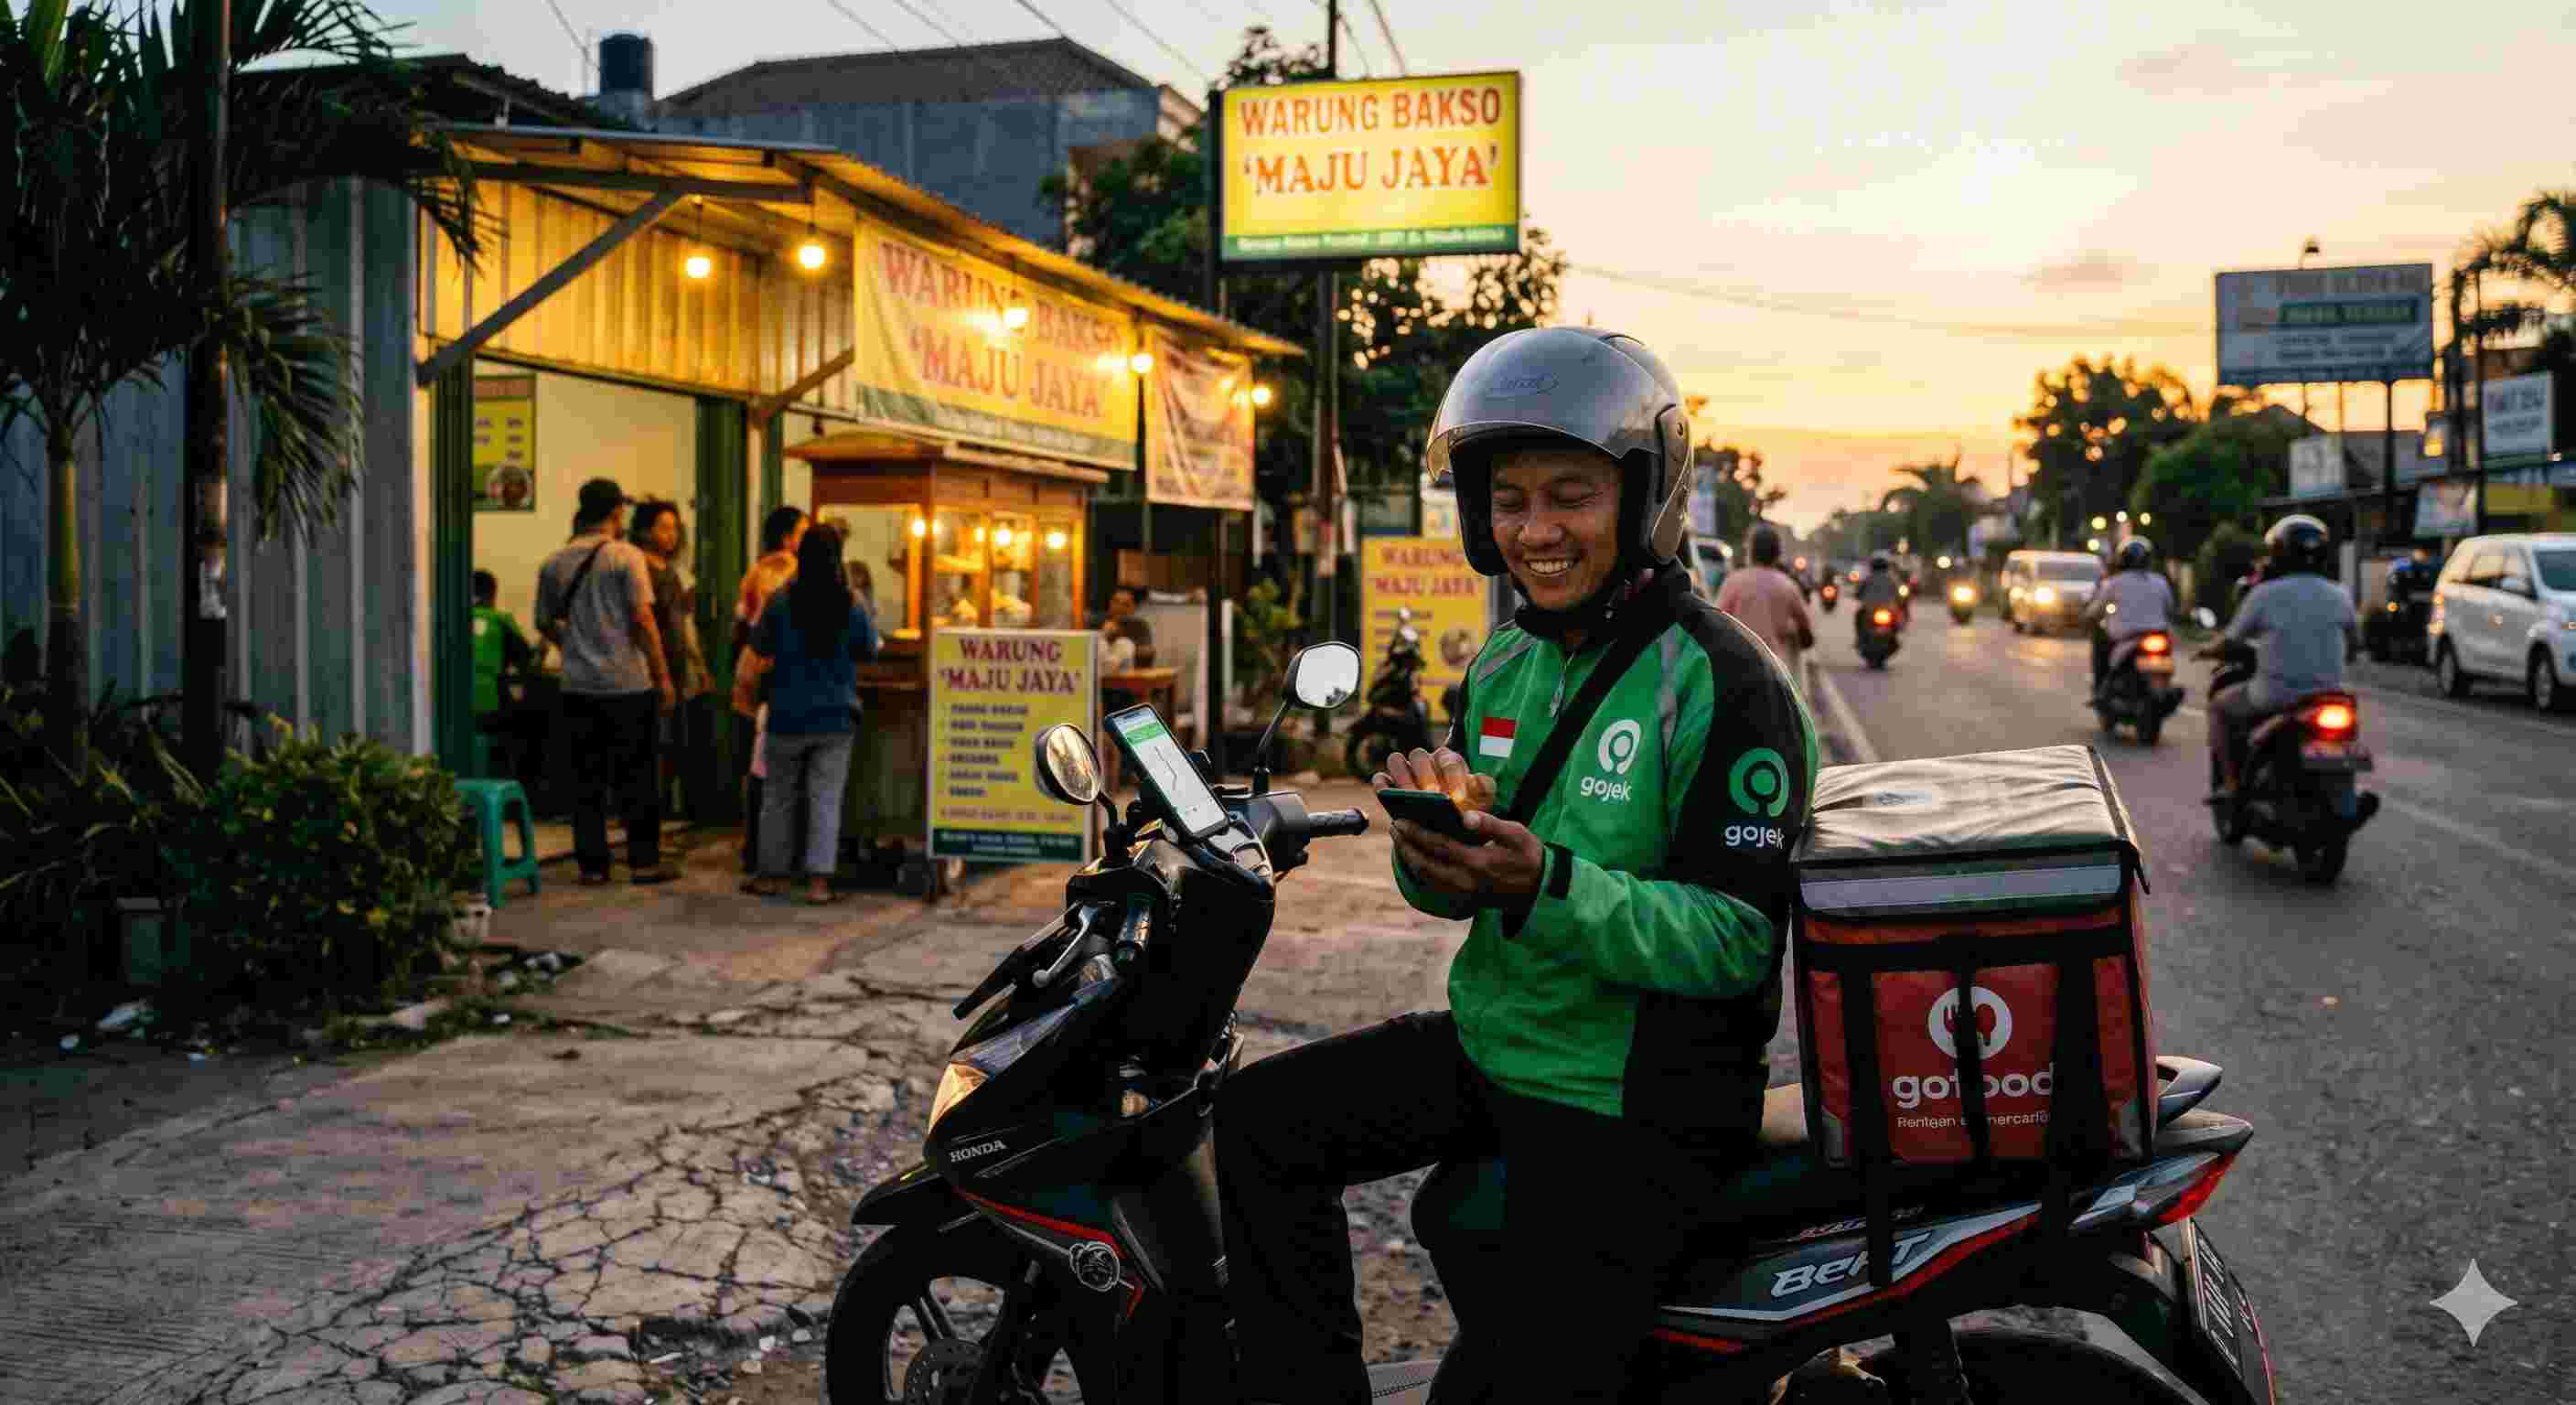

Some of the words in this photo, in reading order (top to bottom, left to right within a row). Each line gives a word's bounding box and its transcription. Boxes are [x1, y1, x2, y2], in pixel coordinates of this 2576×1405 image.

[1240, 93, 1379, 135] WARUNG
[1392, 87, 1501, 129] BAKSO
[959, 638, 1062, 662] WARUNG
[1581, 776, 1633, 801] gojek
[1724, 825, 1785, 849] gojek
[950, 1140, 1006, 1163] HONDA
